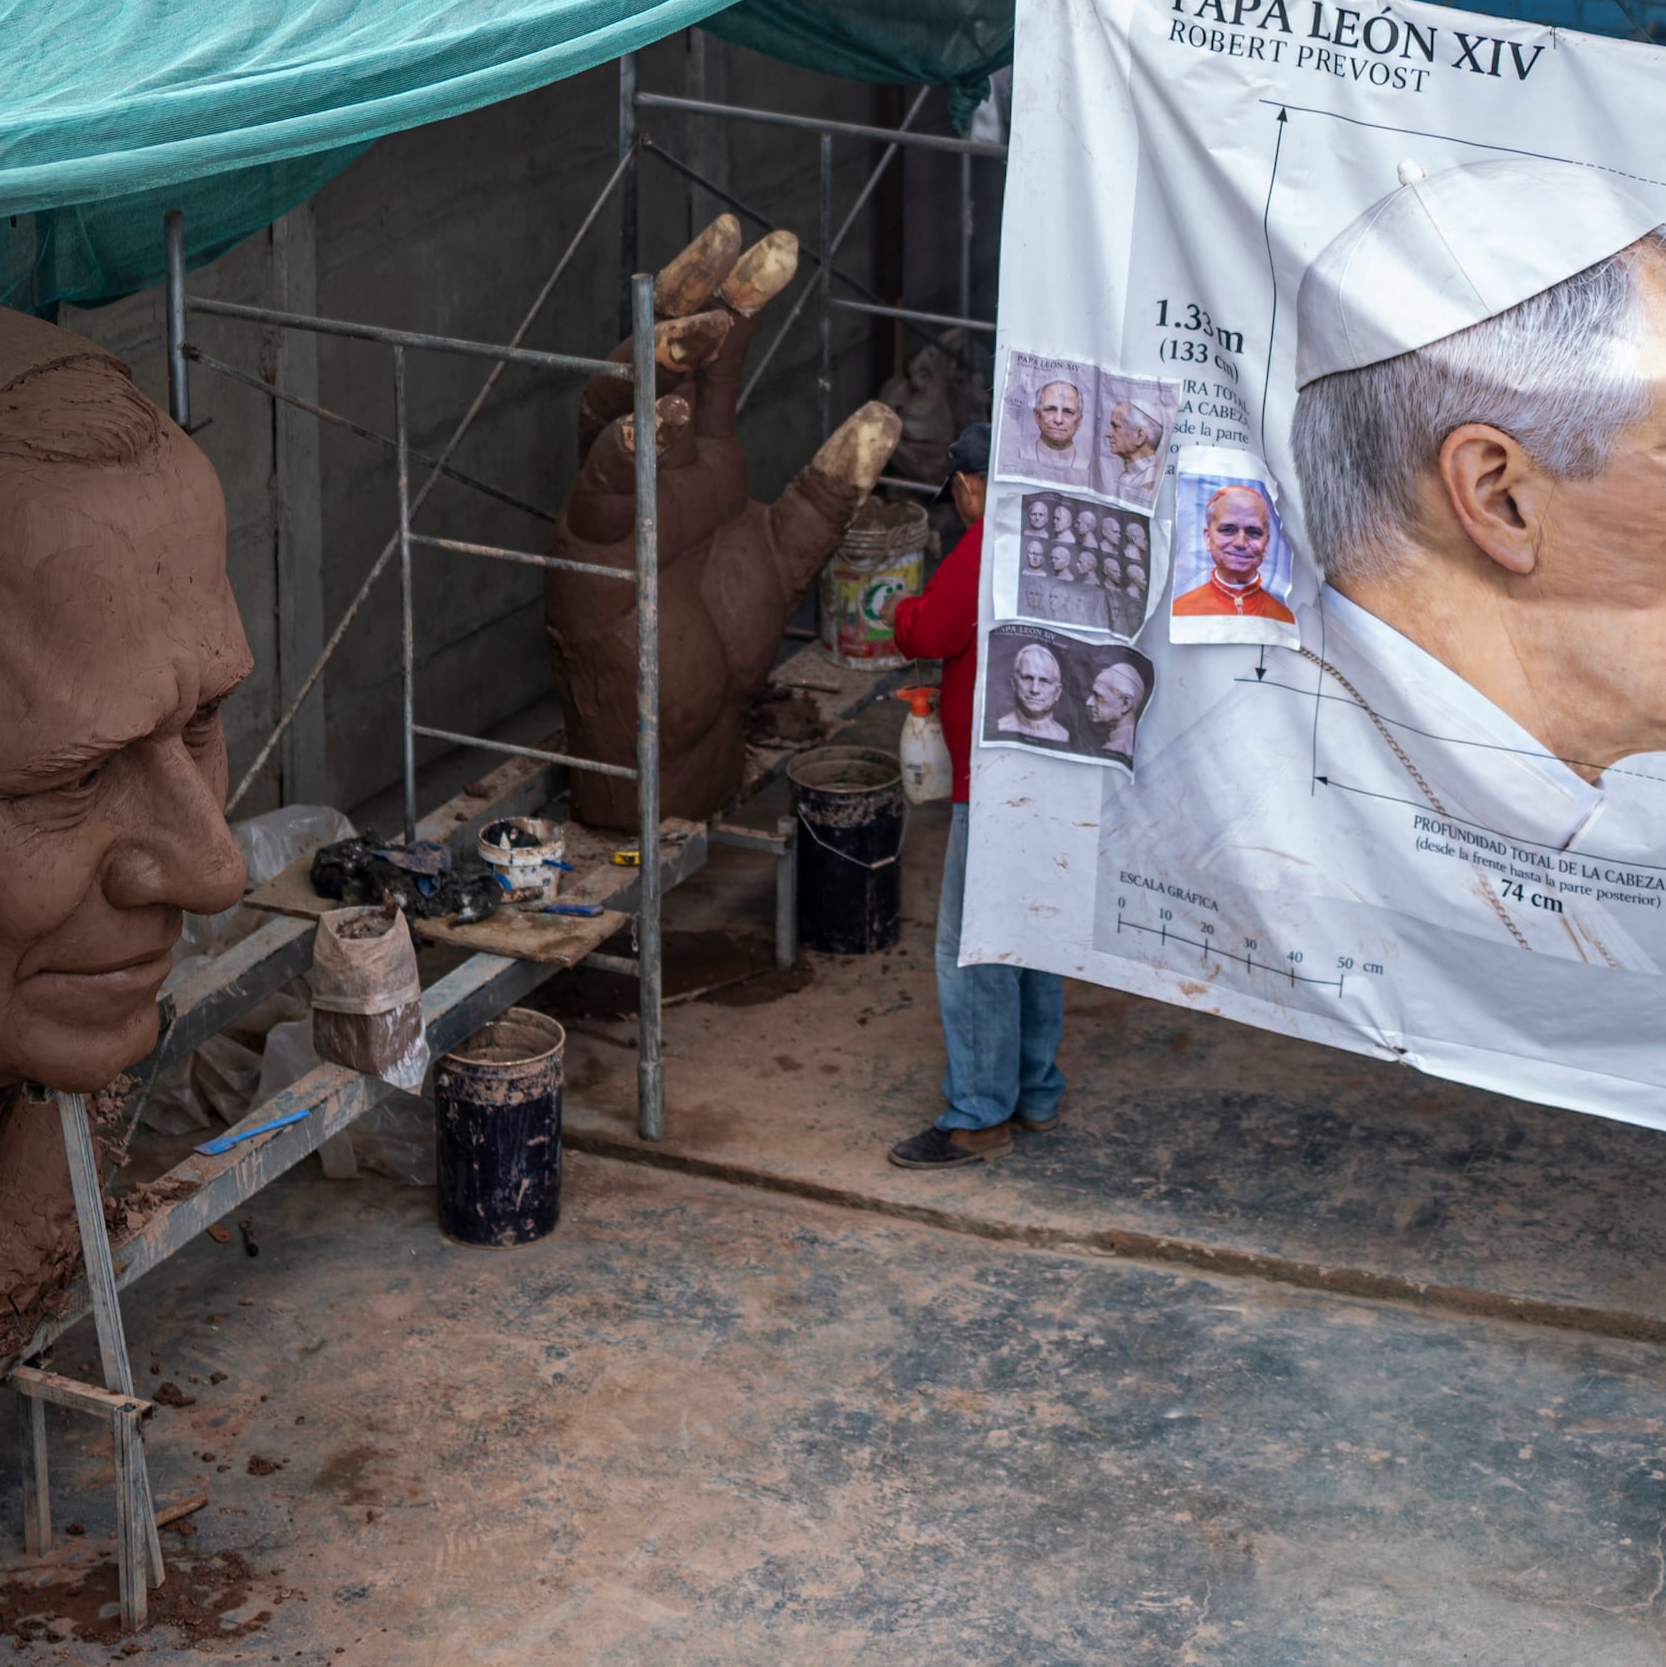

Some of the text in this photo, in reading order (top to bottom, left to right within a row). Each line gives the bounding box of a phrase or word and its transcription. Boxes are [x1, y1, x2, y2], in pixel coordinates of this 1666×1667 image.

[1168, 19, 1430, 93] ROBERT PREVOST
[1308, 2, 1437, 63] LEÓN
[1451, 31, 1545, 81] XIV
[1155, 299, 1244, 354] 1.33 m
[1160, 338, 1239, 385] (133 cm)
[1201, 421, 1249, 444] la parte
[1413, 815, 1666, 891] PROFUNDIDAD TOTAL DE LA CABEZA
[1416, 836, 1662, 909] (desde la frente hasta la parte posterior)
[1120, 871, 1219, 912] ESCALA GRÁFICA
[1500, 879, 1563, 913] 74 cm
[1118, 897, 1383, 974] 0 10 20 30 40 50 cm
